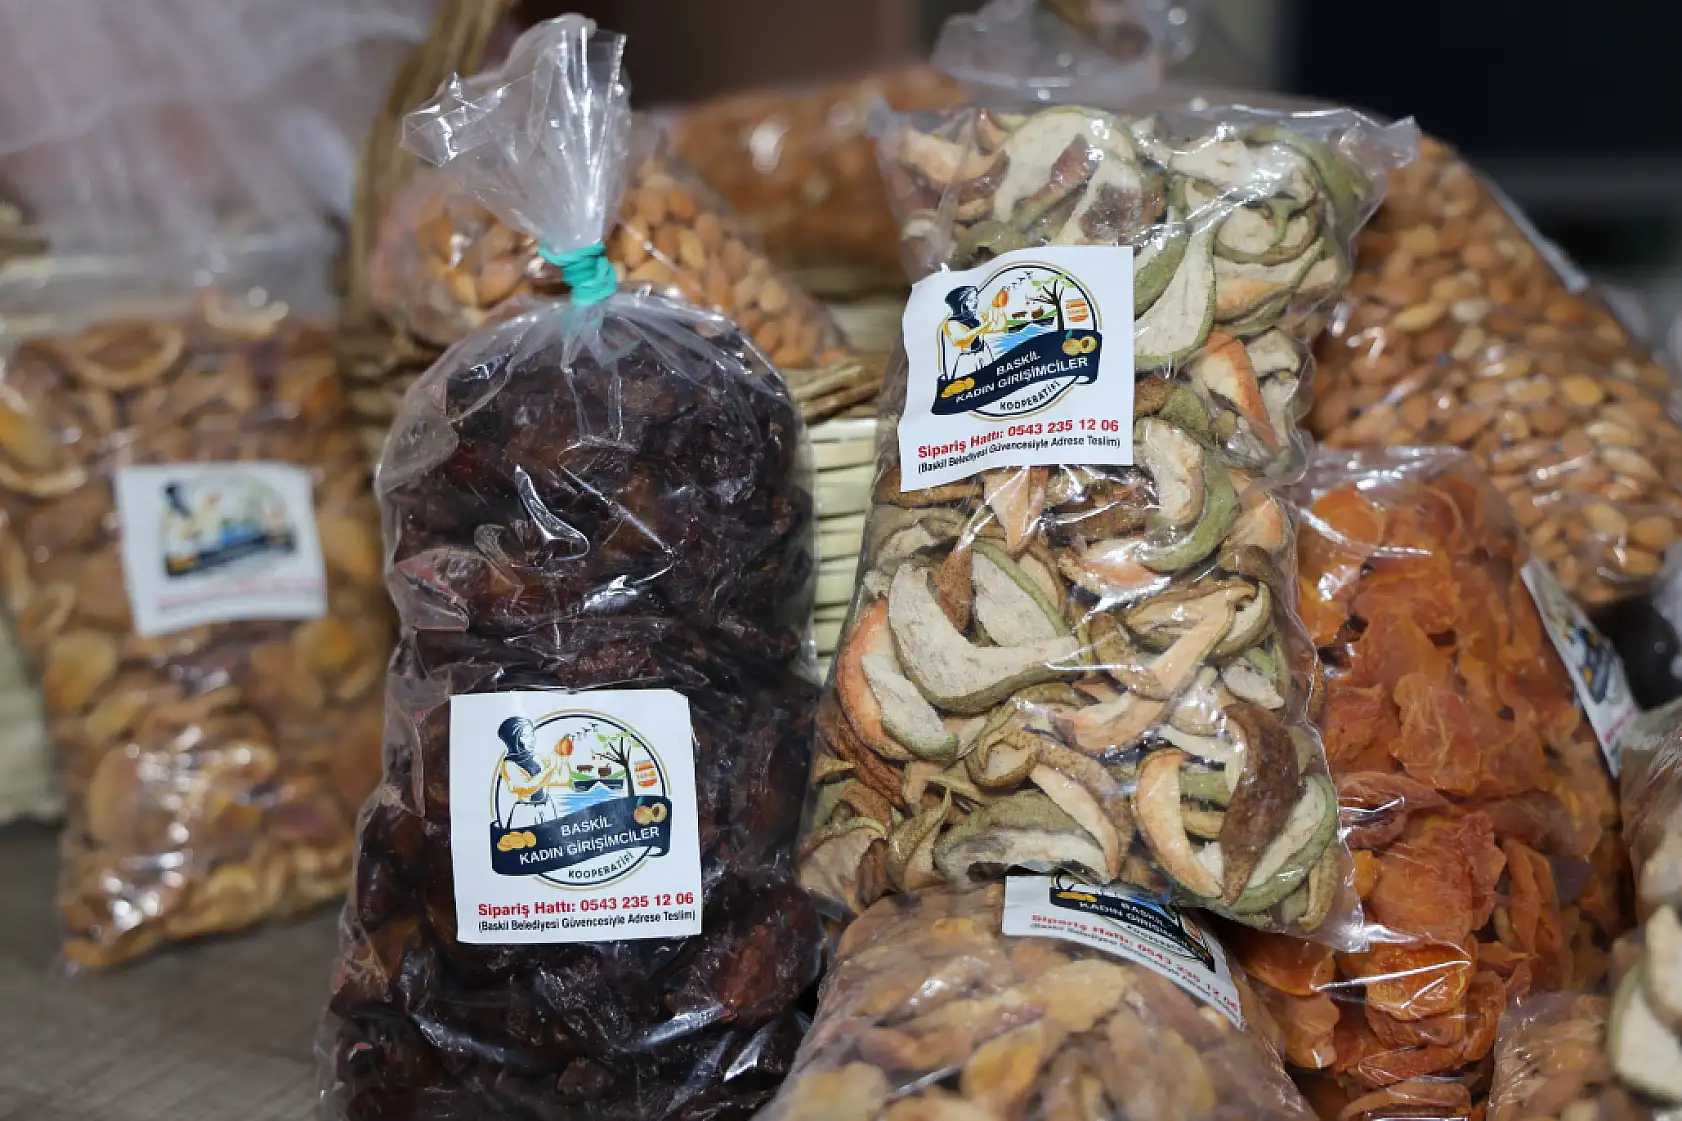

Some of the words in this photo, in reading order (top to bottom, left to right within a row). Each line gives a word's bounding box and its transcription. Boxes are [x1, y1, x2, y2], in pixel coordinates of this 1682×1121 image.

[996, 350, 1041, 376] BASKİL
[956, 383, 995, 403] KADIN
[998, 356, 1089, 388] GİRİŞİMCİLER
[918, 440, 967, 459] Sipariş
[970, 429, 1004, 448] Hattı:
[1007, 422, 1043, 437] 0543
[1047, 419, 1073, 434] 235
[1079, 418, 1096, 431] 12
[1101, 419, 1119, 432] 06
[1051, 436, 1085, 447] Adrese
[1087, 434, 1121, 448] Teslim)
[560, 815, 613, 837] BASKİL
[519, 846, 563, 866] KADIN
[566, 826, 660, 856] GİRİŞİMCİLER
[568, 851, 635, 880] KOOPERATİFİ
[478, 902, 530, 919] Sipariş
[534, 900, 576, 914] Hattı:
[580, 897, 617, 912] 0543
[622, 894, 650, 910] 235
[654, 893, 671, 907] 12
[676, 891, 694, 905] 06
[478, 920, 509, 934] (Baskil
[511, 918, 560, 932] Belediyesi
[562, 912, 625, 929] Güvencesiyle
[628, 912, 661, 924] Adrese
[663, 909, 696, 922] Teslim)
